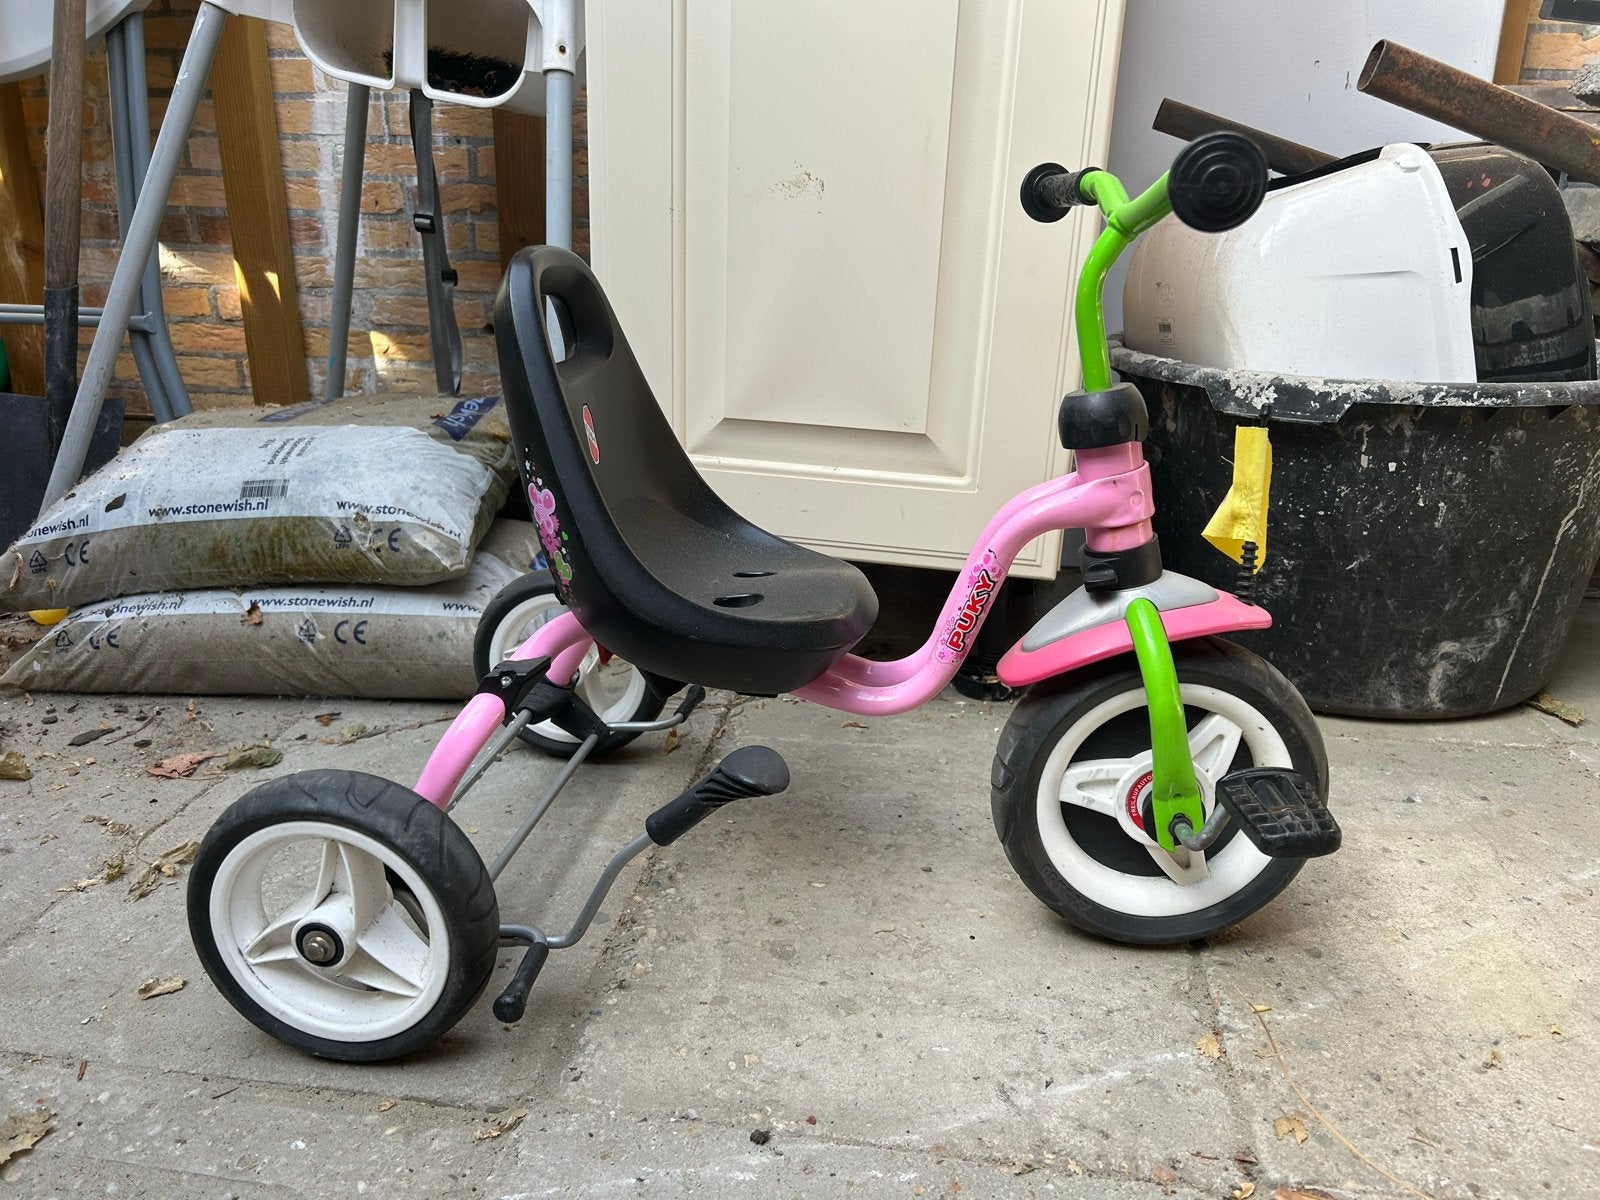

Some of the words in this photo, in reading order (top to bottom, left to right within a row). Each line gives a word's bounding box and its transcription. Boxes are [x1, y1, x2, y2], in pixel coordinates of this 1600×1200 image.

[148, 498, 270, 517] www.stonewish.nl
[336, 500, 462, 540] www.stonewish.nl
[946, 568, 998, 653] PUKY
[1130, 773, 1154, 817] FREILAUFAUTO
